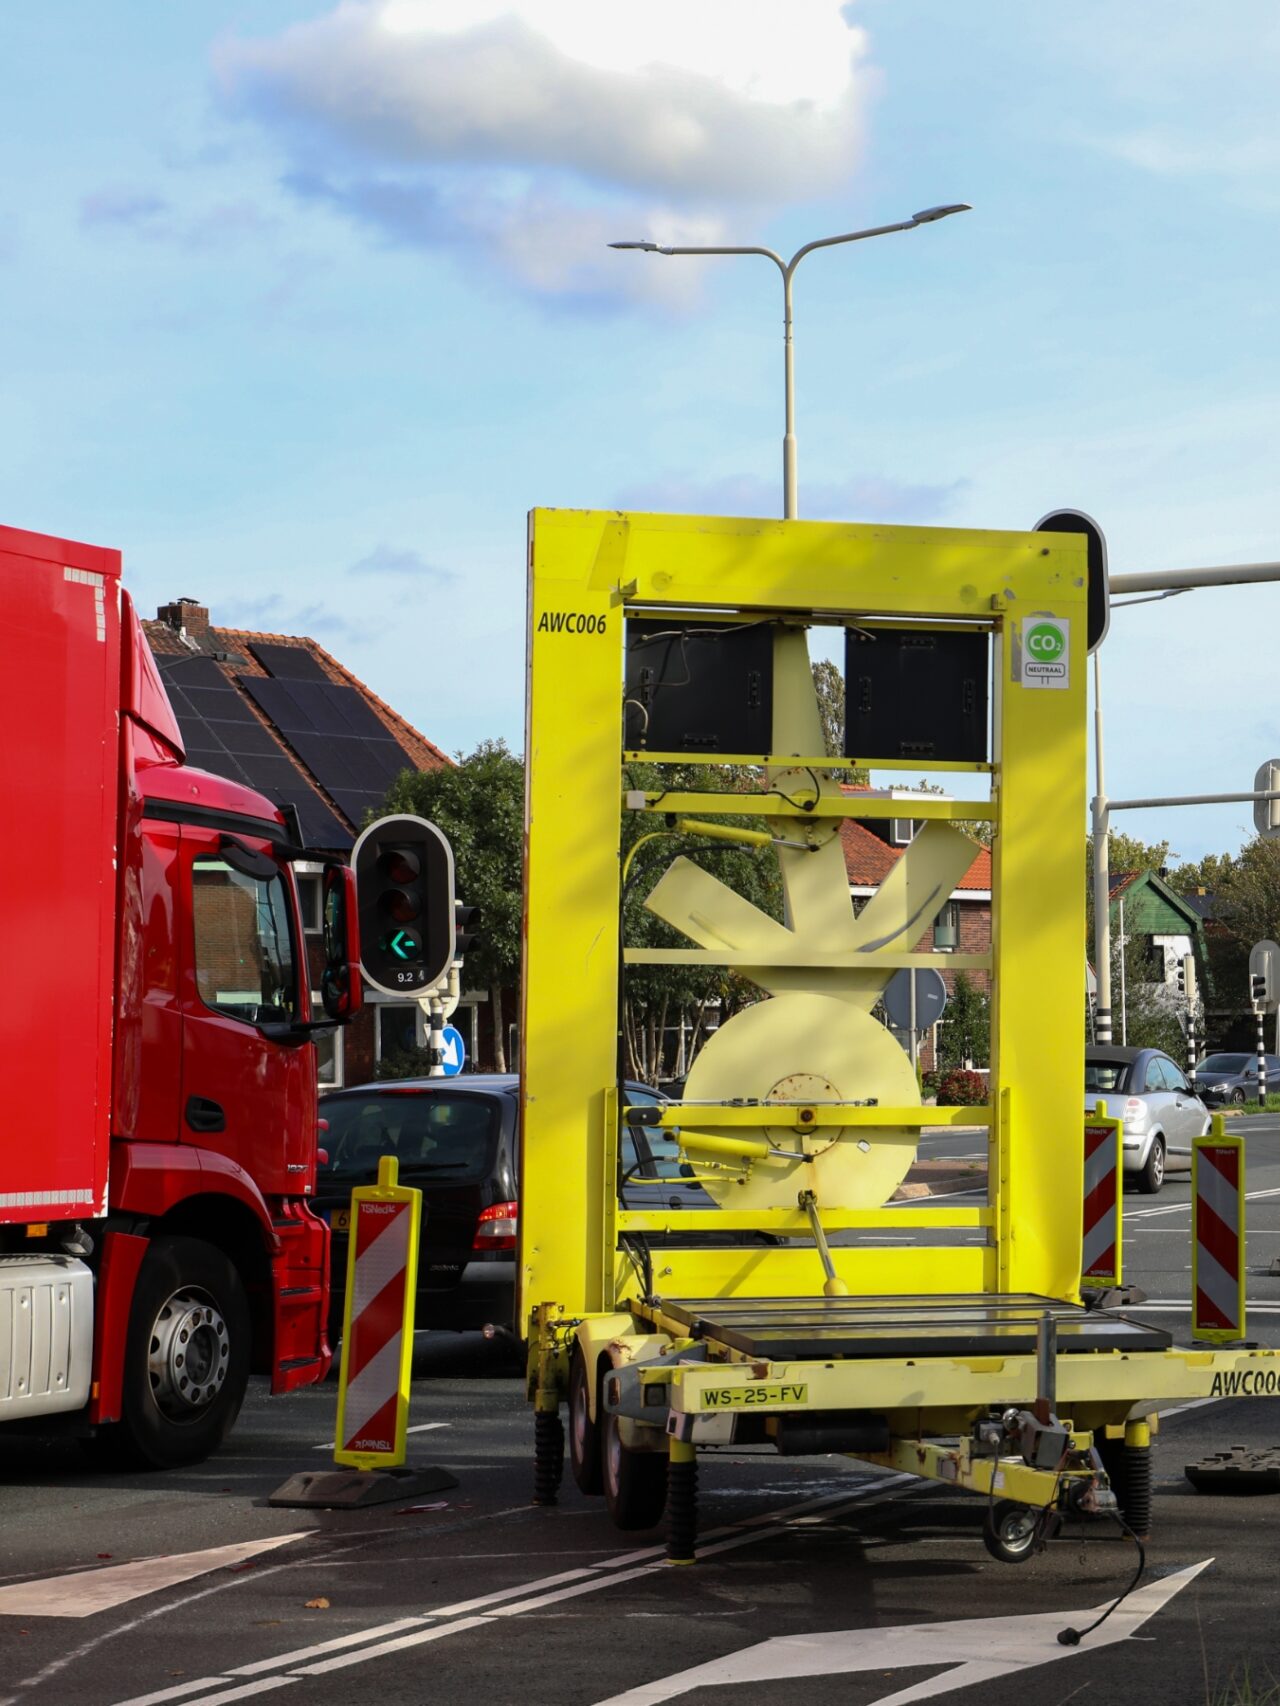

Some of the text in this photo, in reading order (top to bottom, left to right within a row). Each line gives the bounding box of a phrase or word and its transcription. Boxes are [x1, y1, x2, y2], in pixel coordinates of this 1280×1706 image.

[537, 612, 606, 634] AWC006
[1028, 666, 1062, 674] NEUTRAAL
[397, 972, 413, 982] 9.2
[704, 1386, 804, 1406] WS-25-FV
